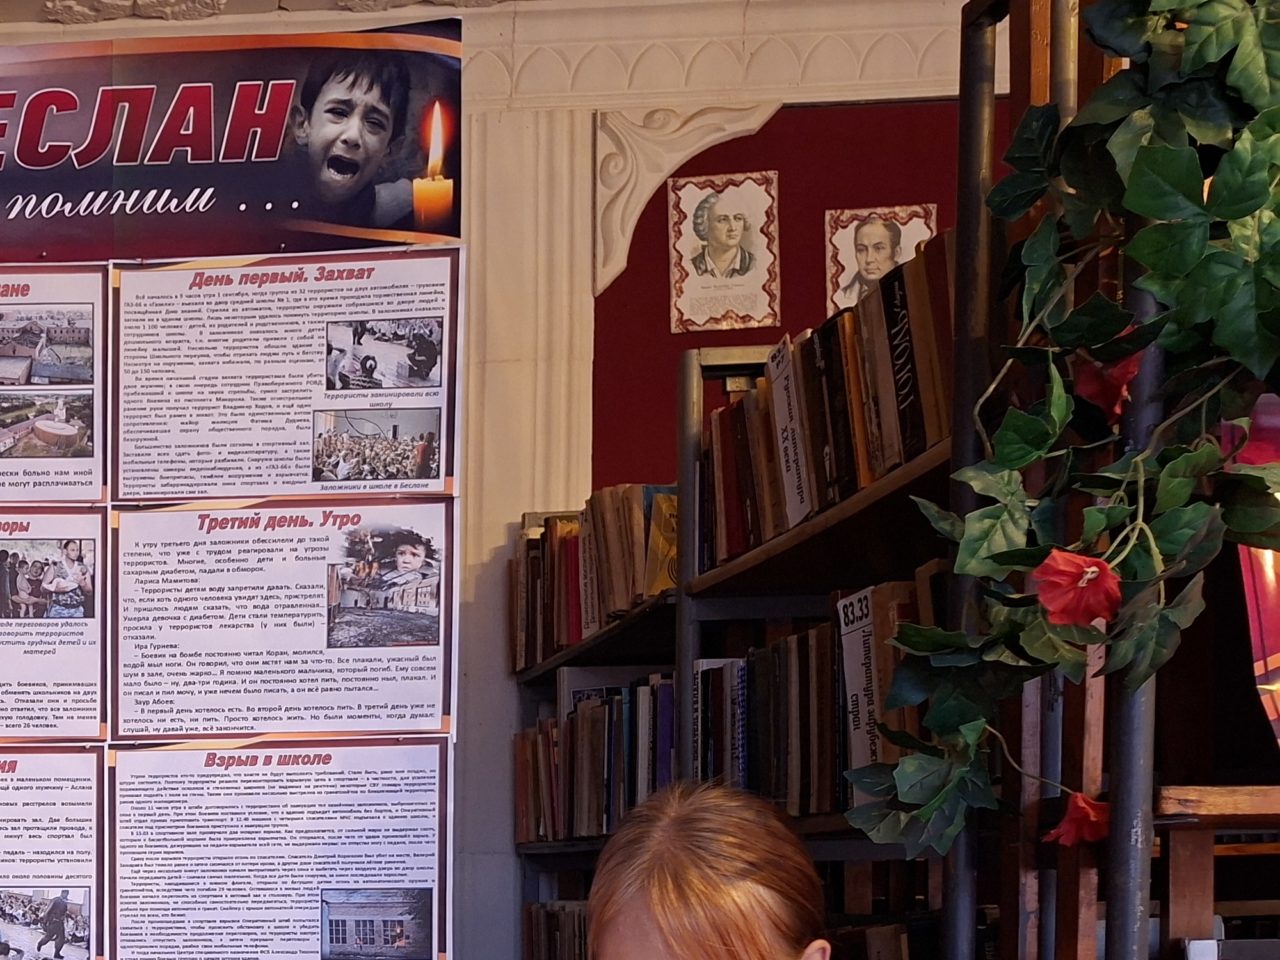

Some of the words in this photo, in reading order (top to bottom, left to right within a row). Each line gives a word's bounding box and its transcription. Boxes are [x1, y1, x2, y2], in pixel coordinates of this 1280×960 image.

[6, 182, 217, 220] помним
[189, 270, 232, 290] День
[239, 266, 307, 289] первый.
[314, 264, 374, 281] Захват
[324, 392, 368, 400] Террористы
[783, 374, 793, 423] Русская
[790, 427, 805, 504] литература
[783, 446, 791, 472] века
[198, 512, 260, 531] Третий
[264, 515, 313, 530] день.
[320, 510, 360, 530] Утро
[842, 594, 870, 628] 83.33
[862, 630, 875, 707] Литература
[204, 752, 257, 770] Взрыв
[277, 753, 331, 765] школе
